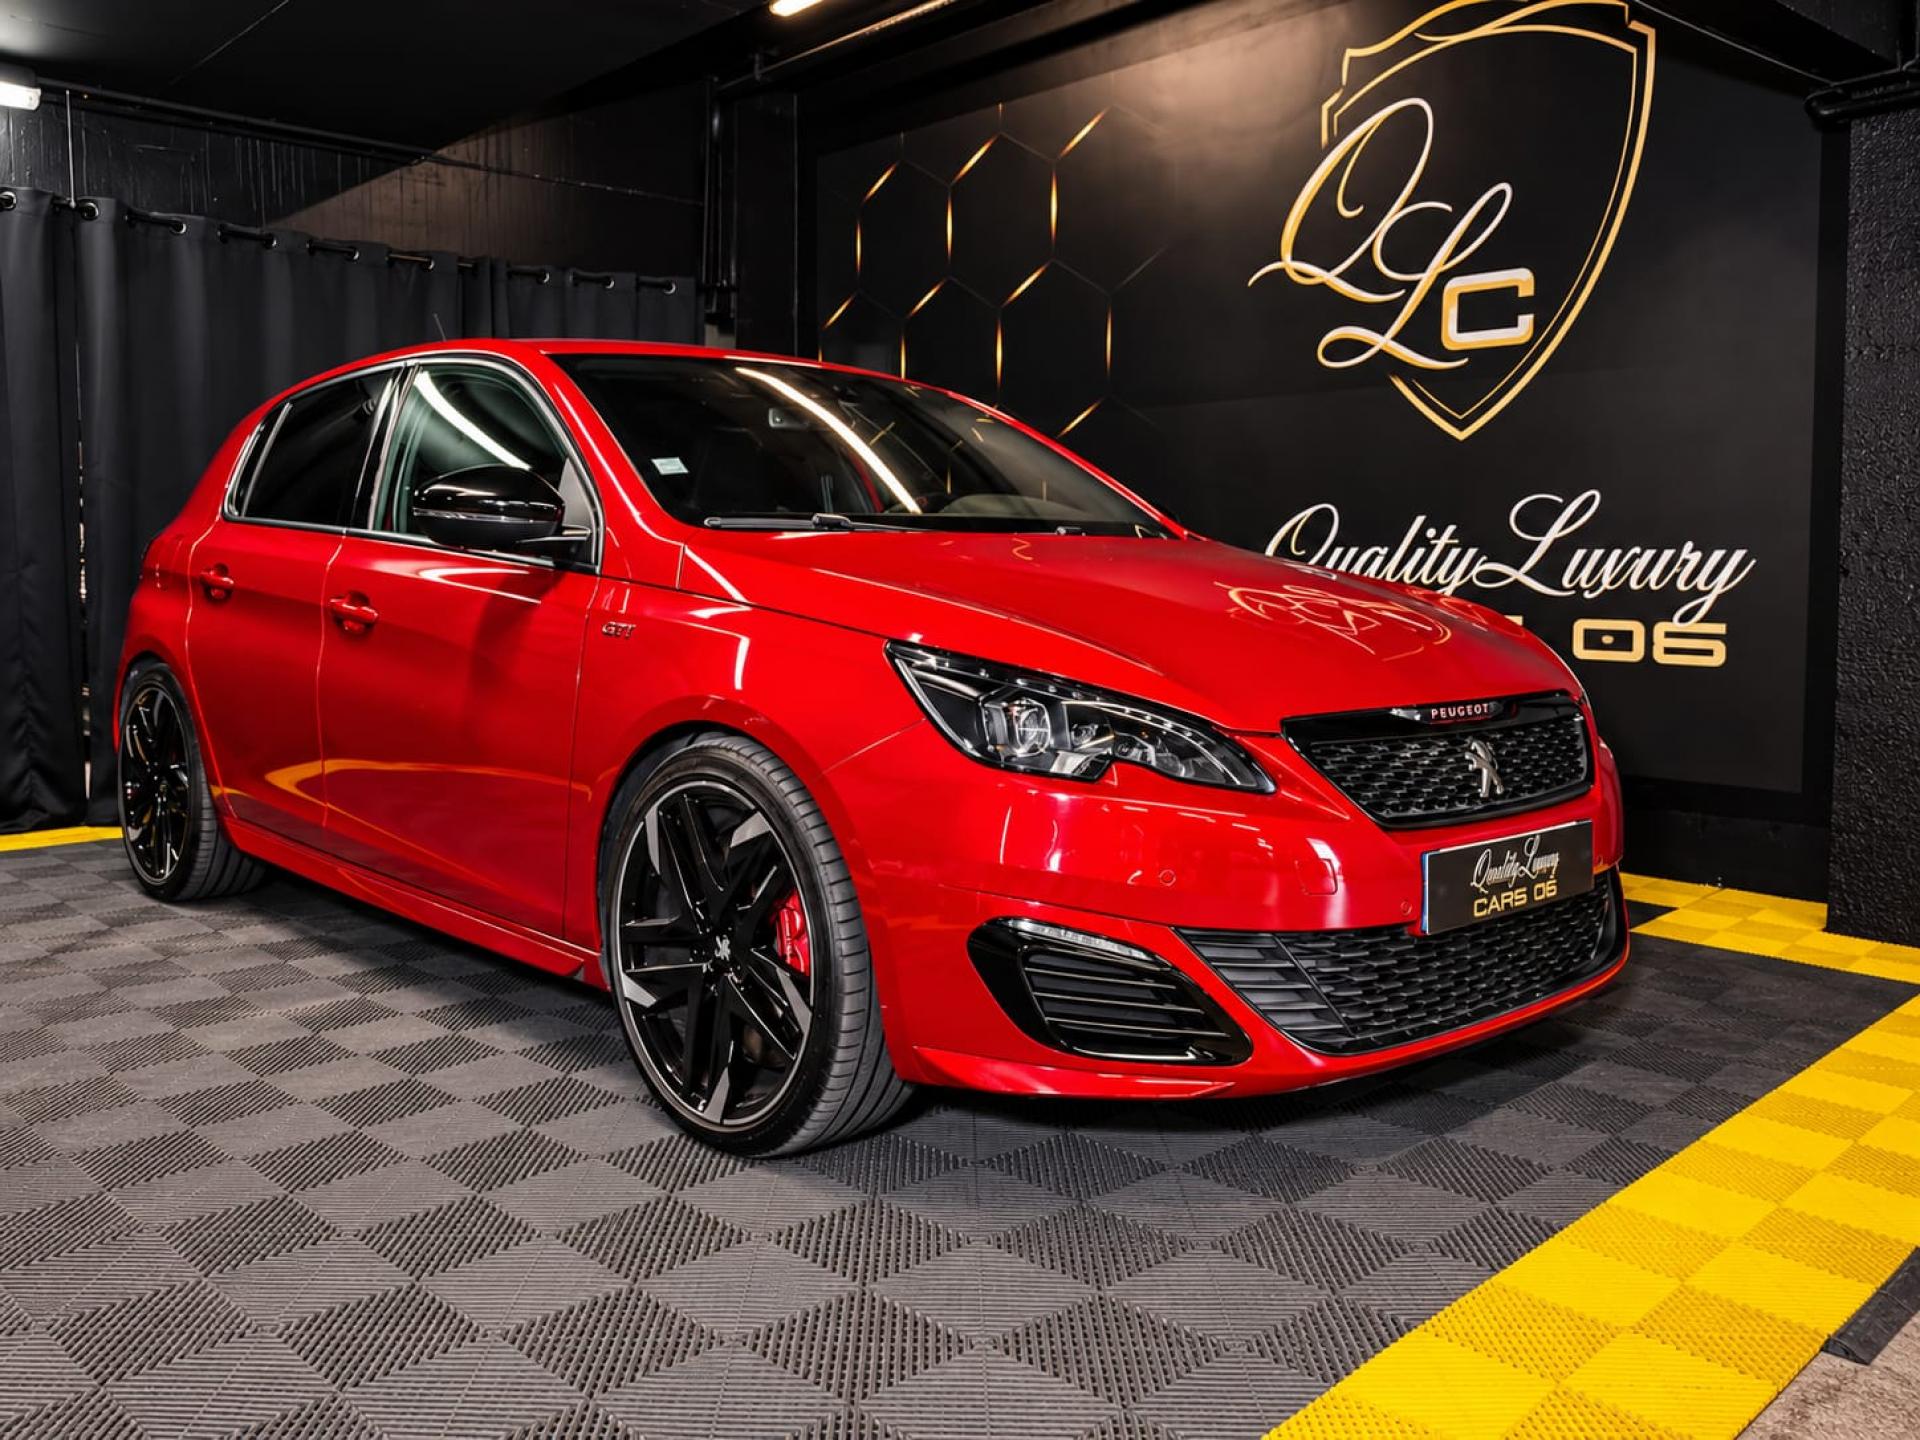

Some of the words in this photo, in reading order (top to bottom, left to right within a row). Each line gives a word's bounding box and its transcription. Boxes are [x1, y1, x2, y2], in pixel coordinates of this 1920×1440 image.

[1472, 488, 1757, 627] Luxury
[1572, 618, 1728, 668] 06
[1431, 703, 1490, 719] PEUGEOT
[1473, 887, 1528, 917] CARS
[1533, 879, 1558, 898] 06
